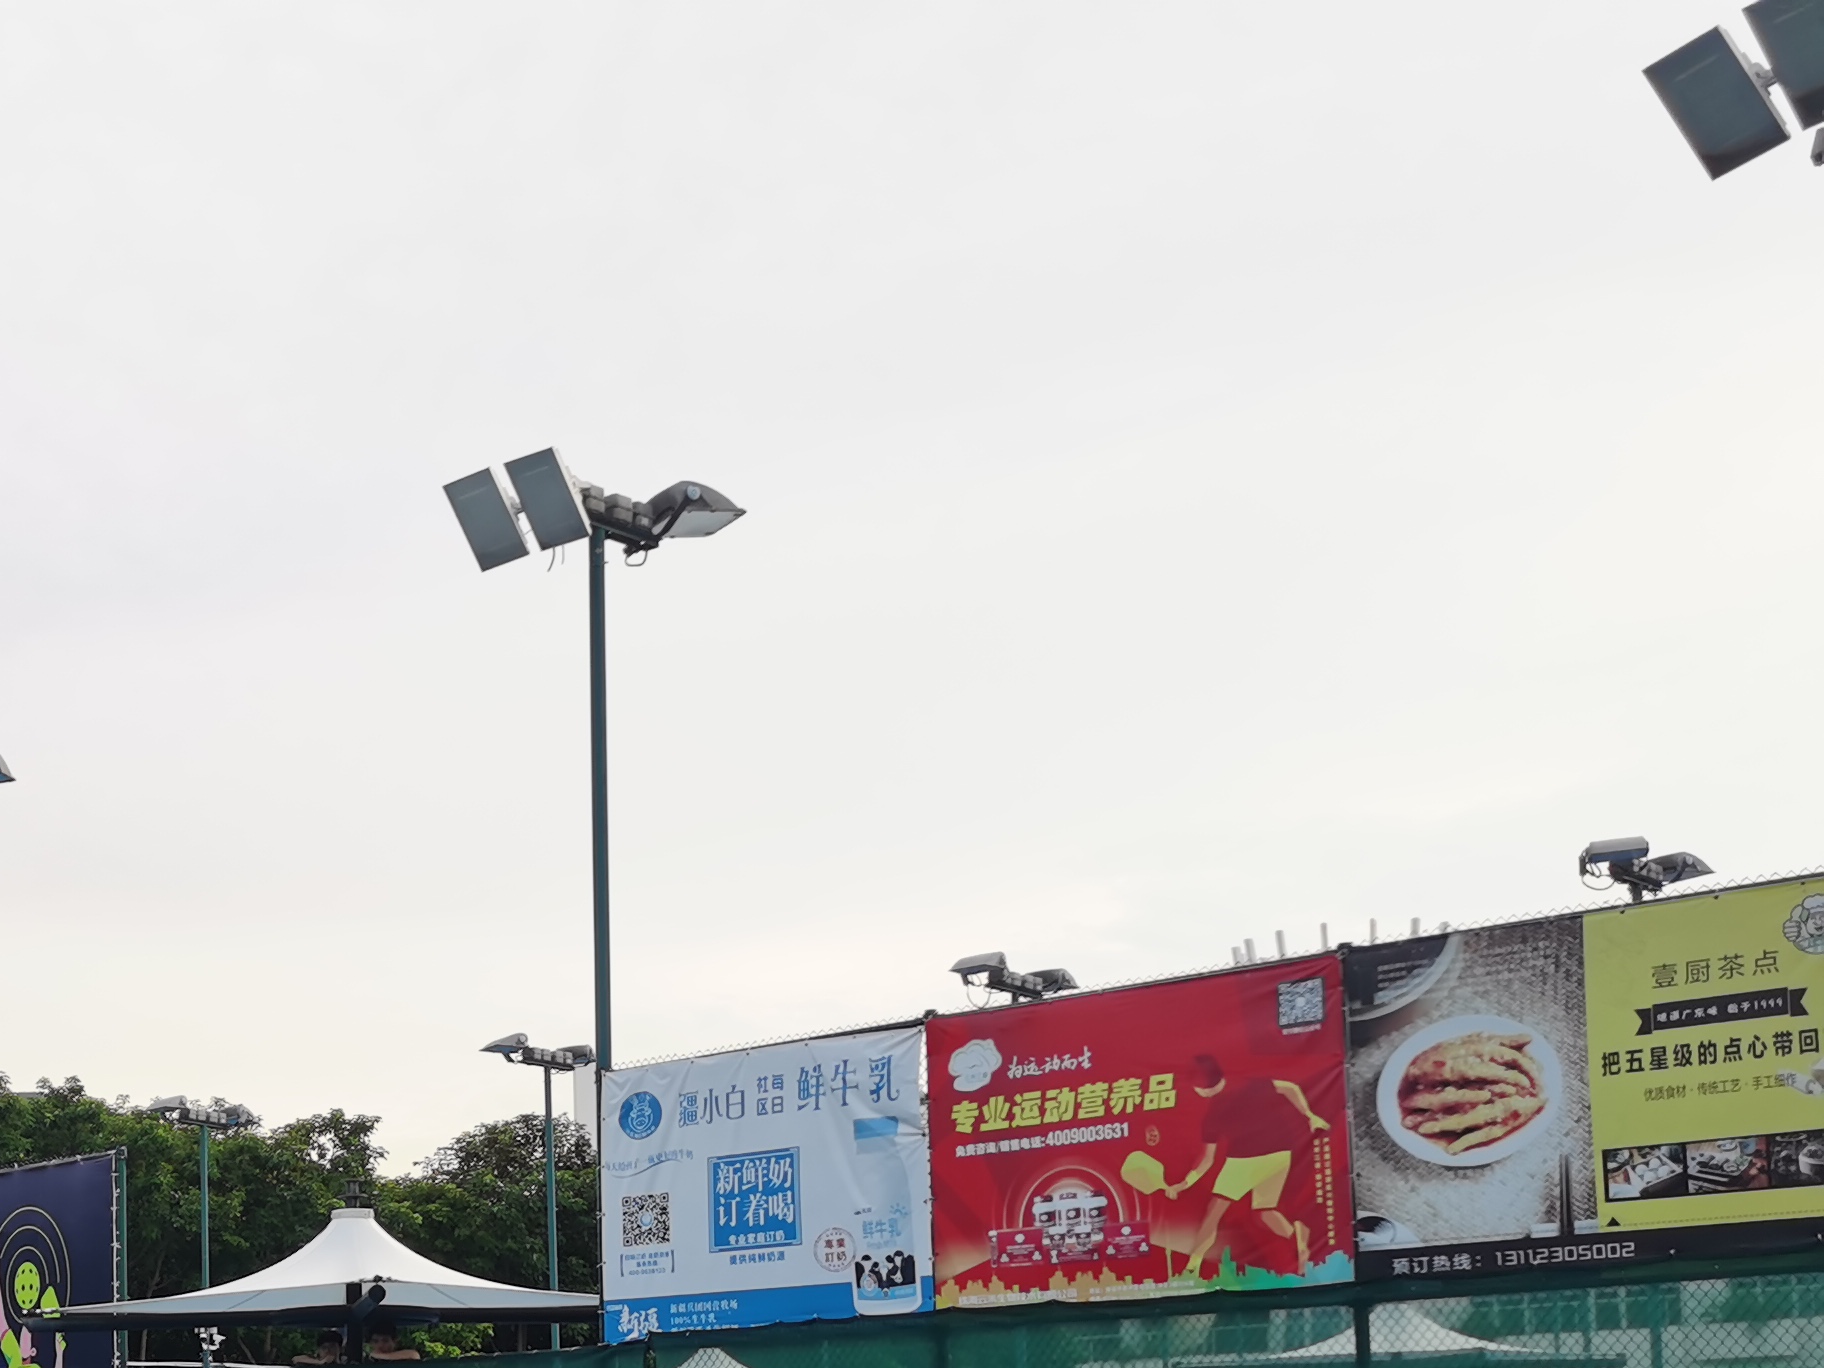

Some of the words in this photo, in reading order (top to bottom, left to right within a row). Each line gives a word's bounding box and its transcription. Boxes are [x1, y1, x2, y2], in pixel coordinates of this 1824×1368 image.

[1651, 949, 1780, 990] 壹厨茶点
[1601, 1028, 1820, 1077] 把五星级的点心带回
[797, 1054, 900, 1111] 鲜牛乳
[950, 1072, 1177, 1134] 专业运动营养品
[715, 1157, 793, 1195] 新鲜奶
[716, 1190, 794, 1228] 订着喝
[1495, 1242, 1636, 1266] 13112305002
